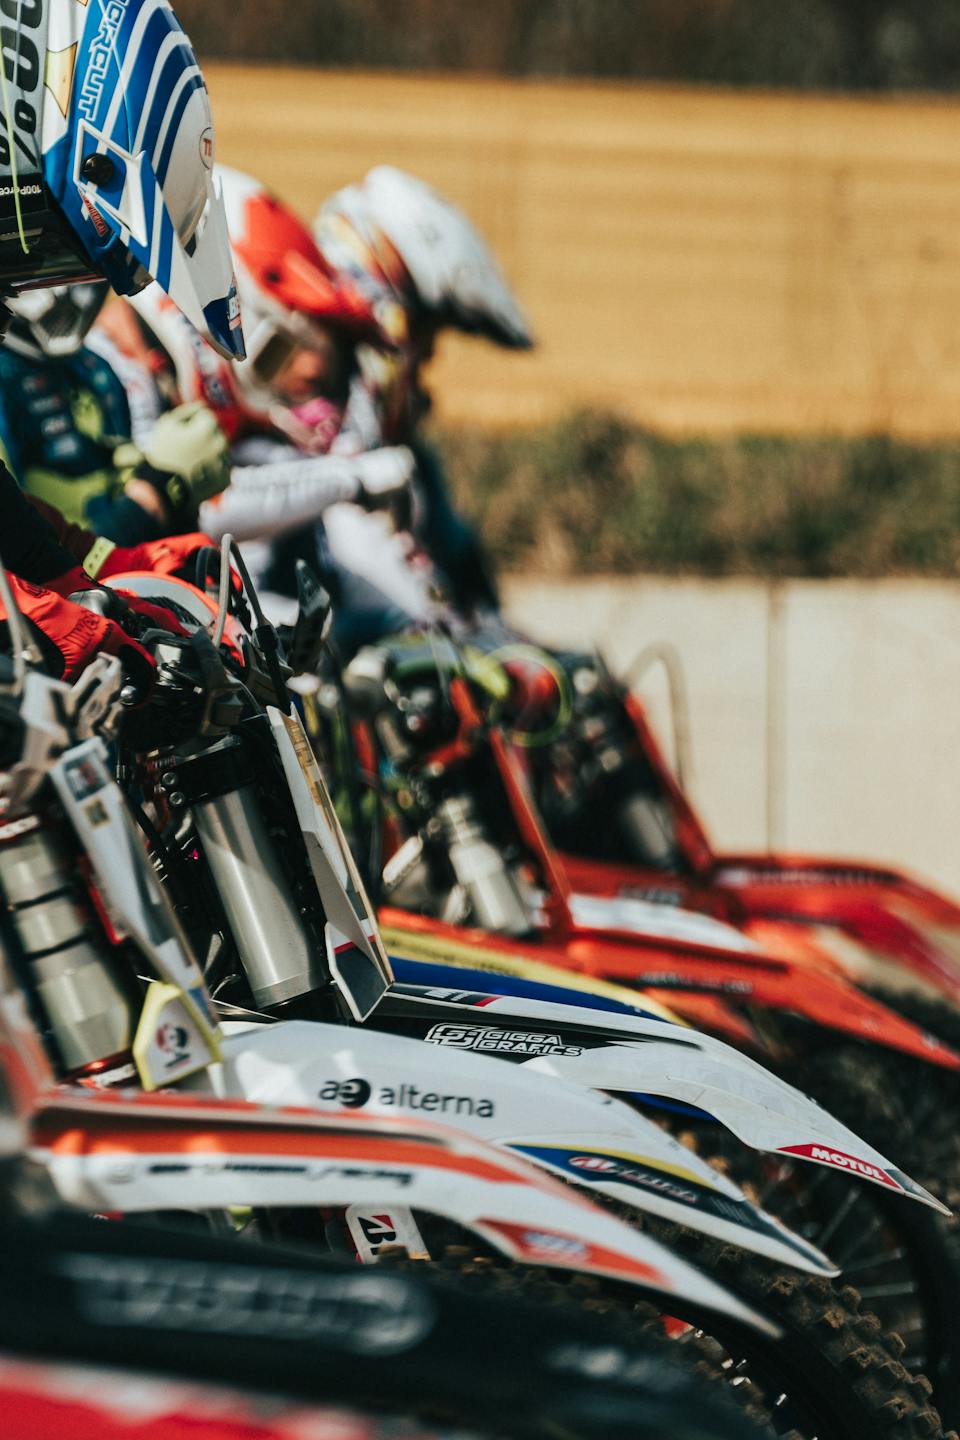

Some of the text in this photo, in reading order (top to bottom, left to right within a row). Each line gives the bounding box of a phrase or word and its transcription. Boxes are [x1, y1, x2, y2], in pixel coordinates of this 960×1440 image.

[478, 1039, 584, 1057] GRAFICS
[483, 1030, 559, 1046] GIGGA
[379, 1084, 495, 1119] alterna
[811, 1147, 884, 1181] MOTUL
